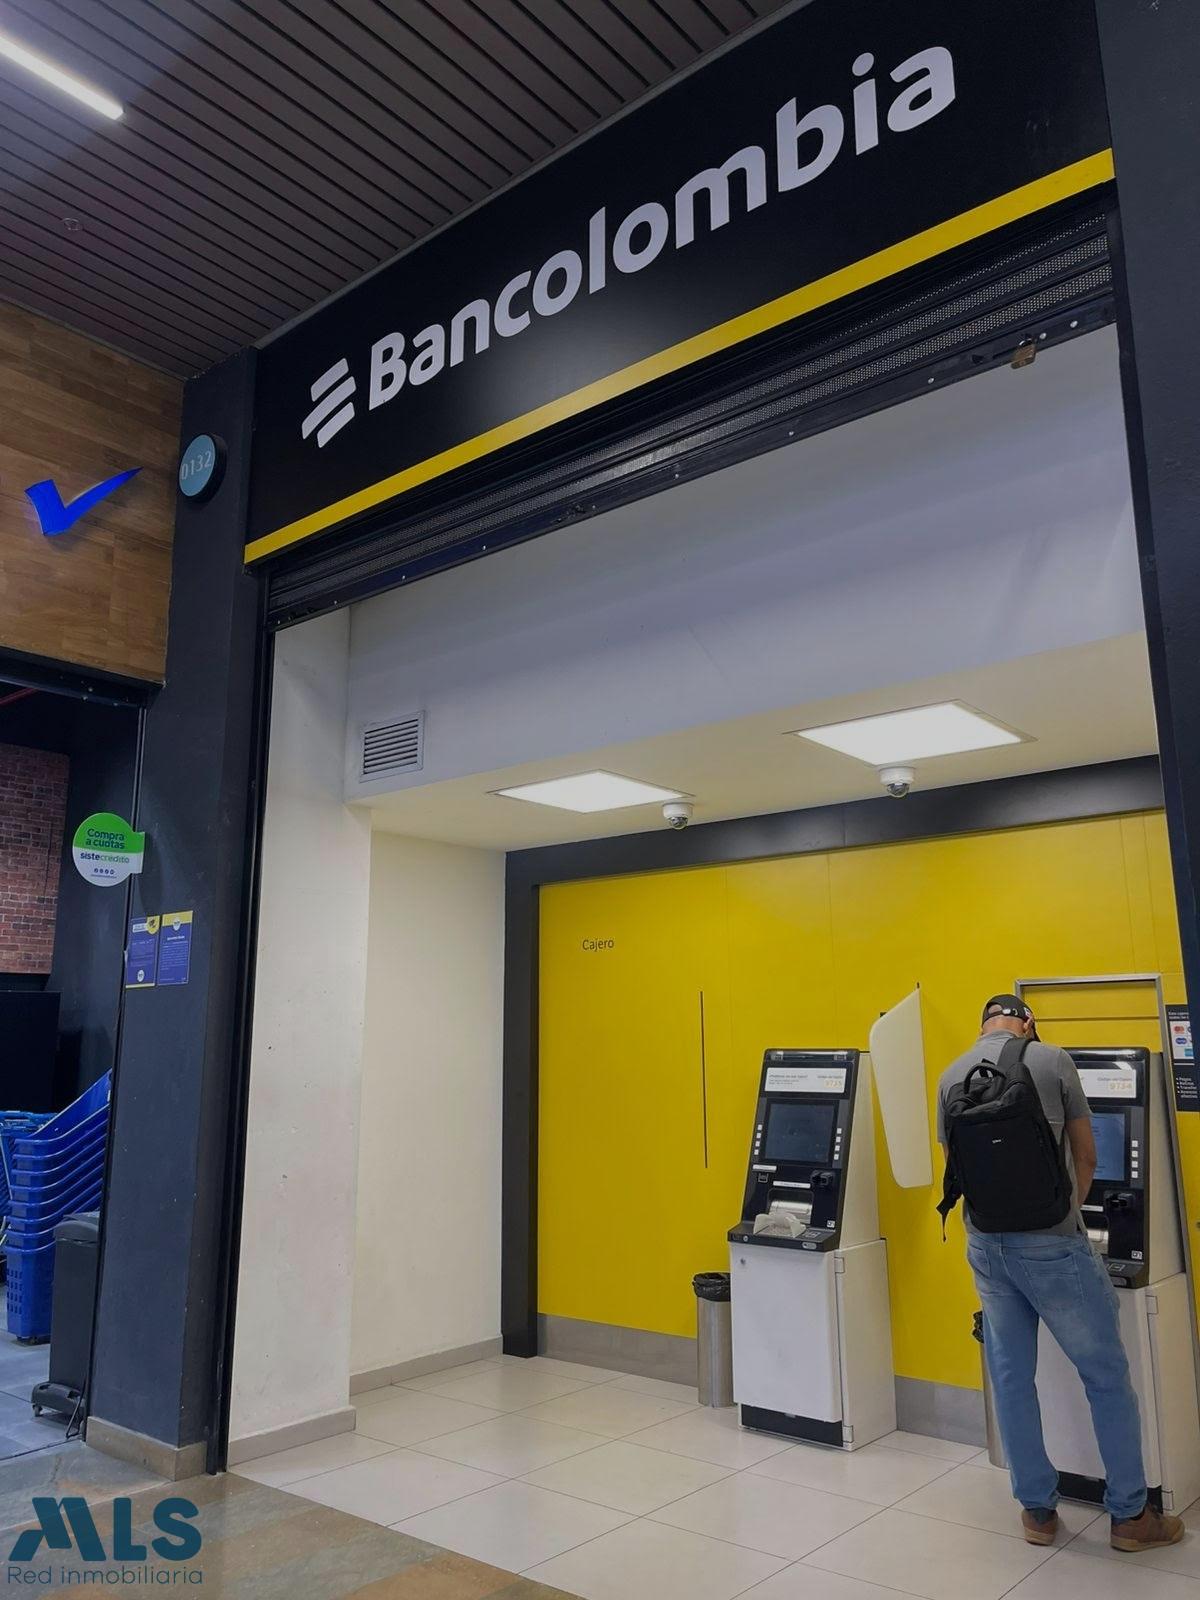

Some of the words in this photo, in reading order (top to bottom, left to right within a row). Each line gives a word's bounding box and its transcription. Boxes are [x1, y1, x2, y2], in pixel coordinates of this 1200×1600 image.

[368, 46, 956, 411] Bancolombia
[181, 450, 212, 480] 0132
[87, 828, 125, 841] Compra
[85, 838, 92, 846] a
[93, 839, 126, 850] cuotas
[582, 938, 615, 952] Cajero
